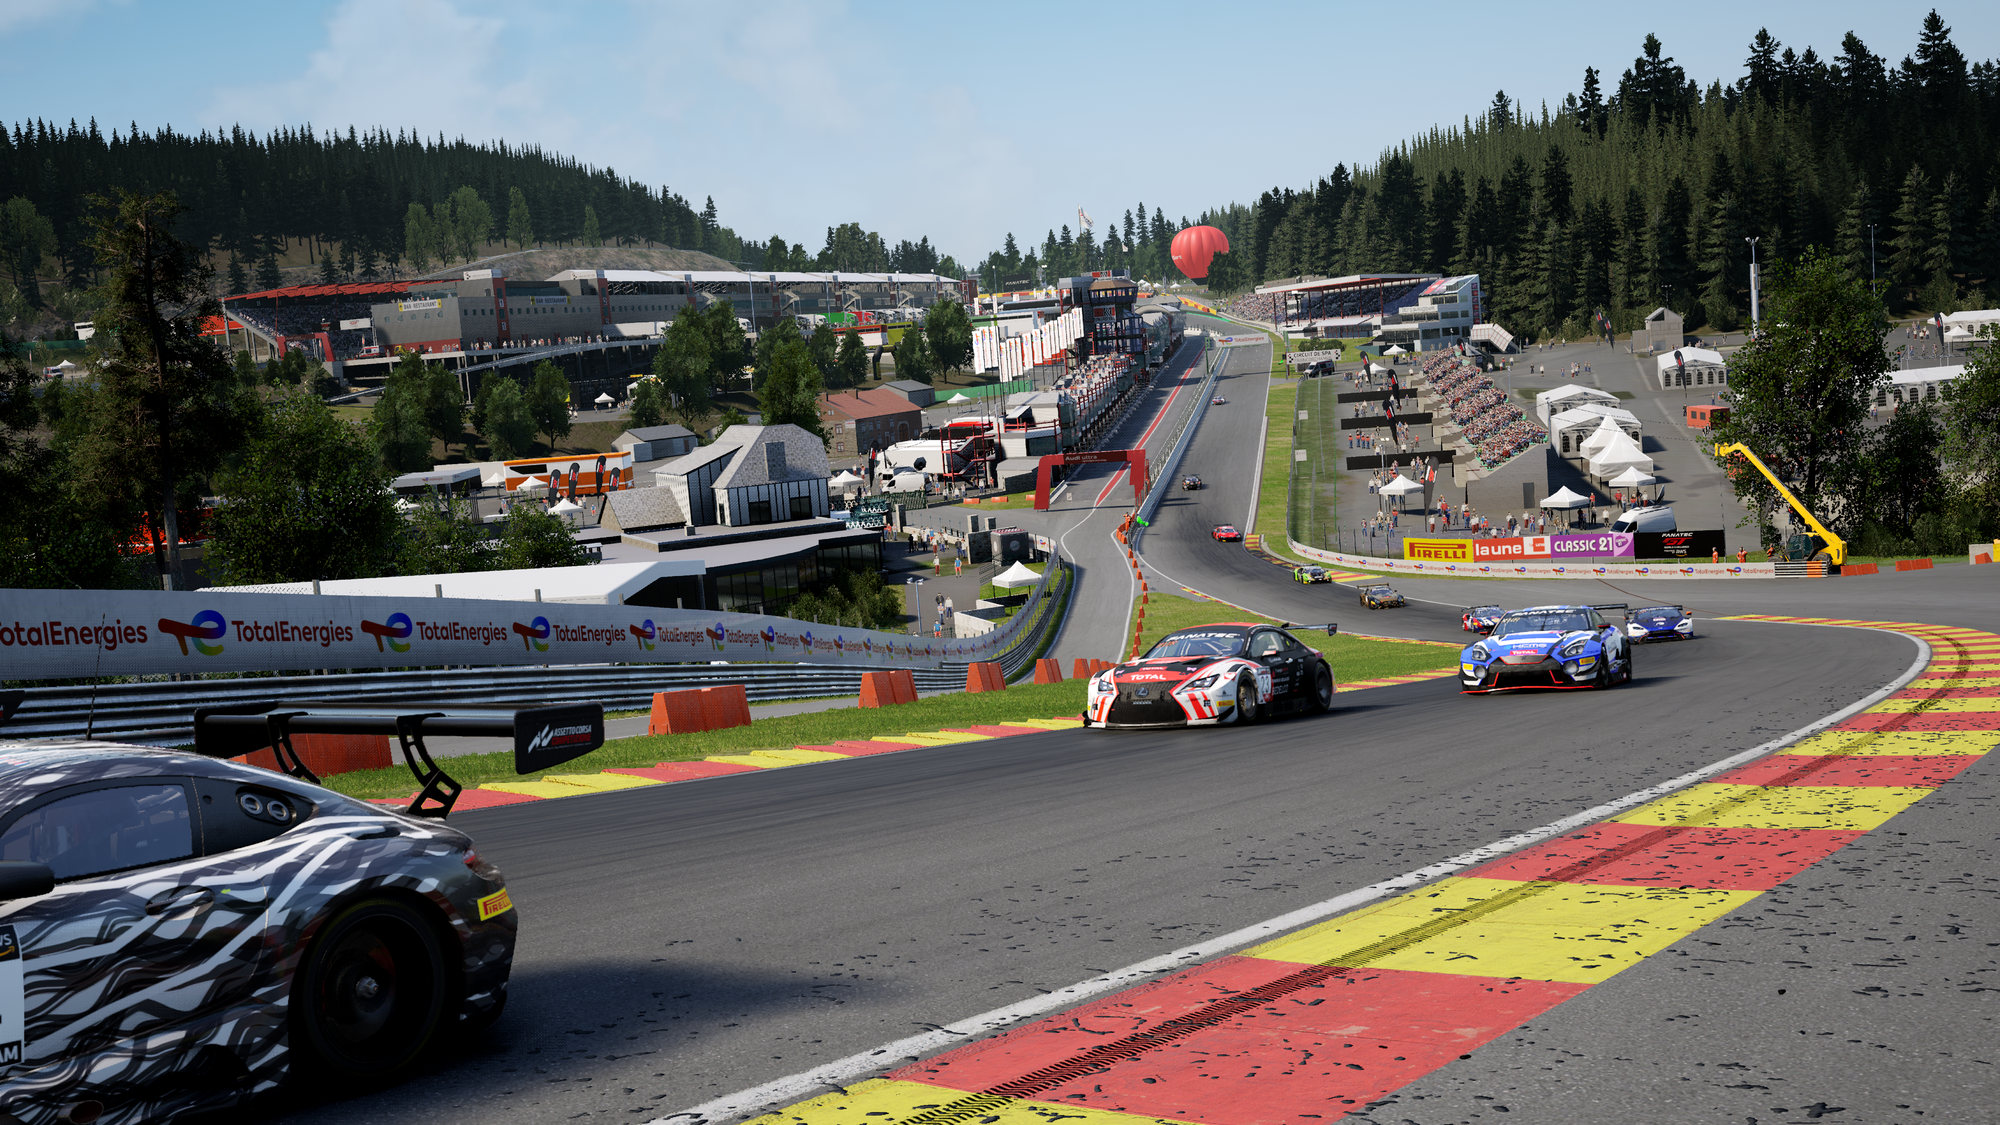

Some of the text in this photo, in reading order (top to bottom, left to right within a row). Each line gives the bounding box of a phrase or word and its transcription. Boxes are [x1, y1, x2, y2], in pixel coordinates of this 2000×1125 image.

[1409, 542, 1466, 559] PIRELLI
[1554, 537, 1613, 552] CLASSIC 21
[0, 619, 148, 651] otalEnergies
[231, 620, 353, 647] TotalEnergies
[416, 621, 508, 646] TotalEnergies
[552, 625, 626, 646] TotalEnergies
[657, 626, 704, 647] TotalEnergies
[1130, 673, 1167, 681] TOTAL
[551, 733, 592, 746] COMPETIZIONE
[554, 724, 592, 737] ASSETTO CORSA
